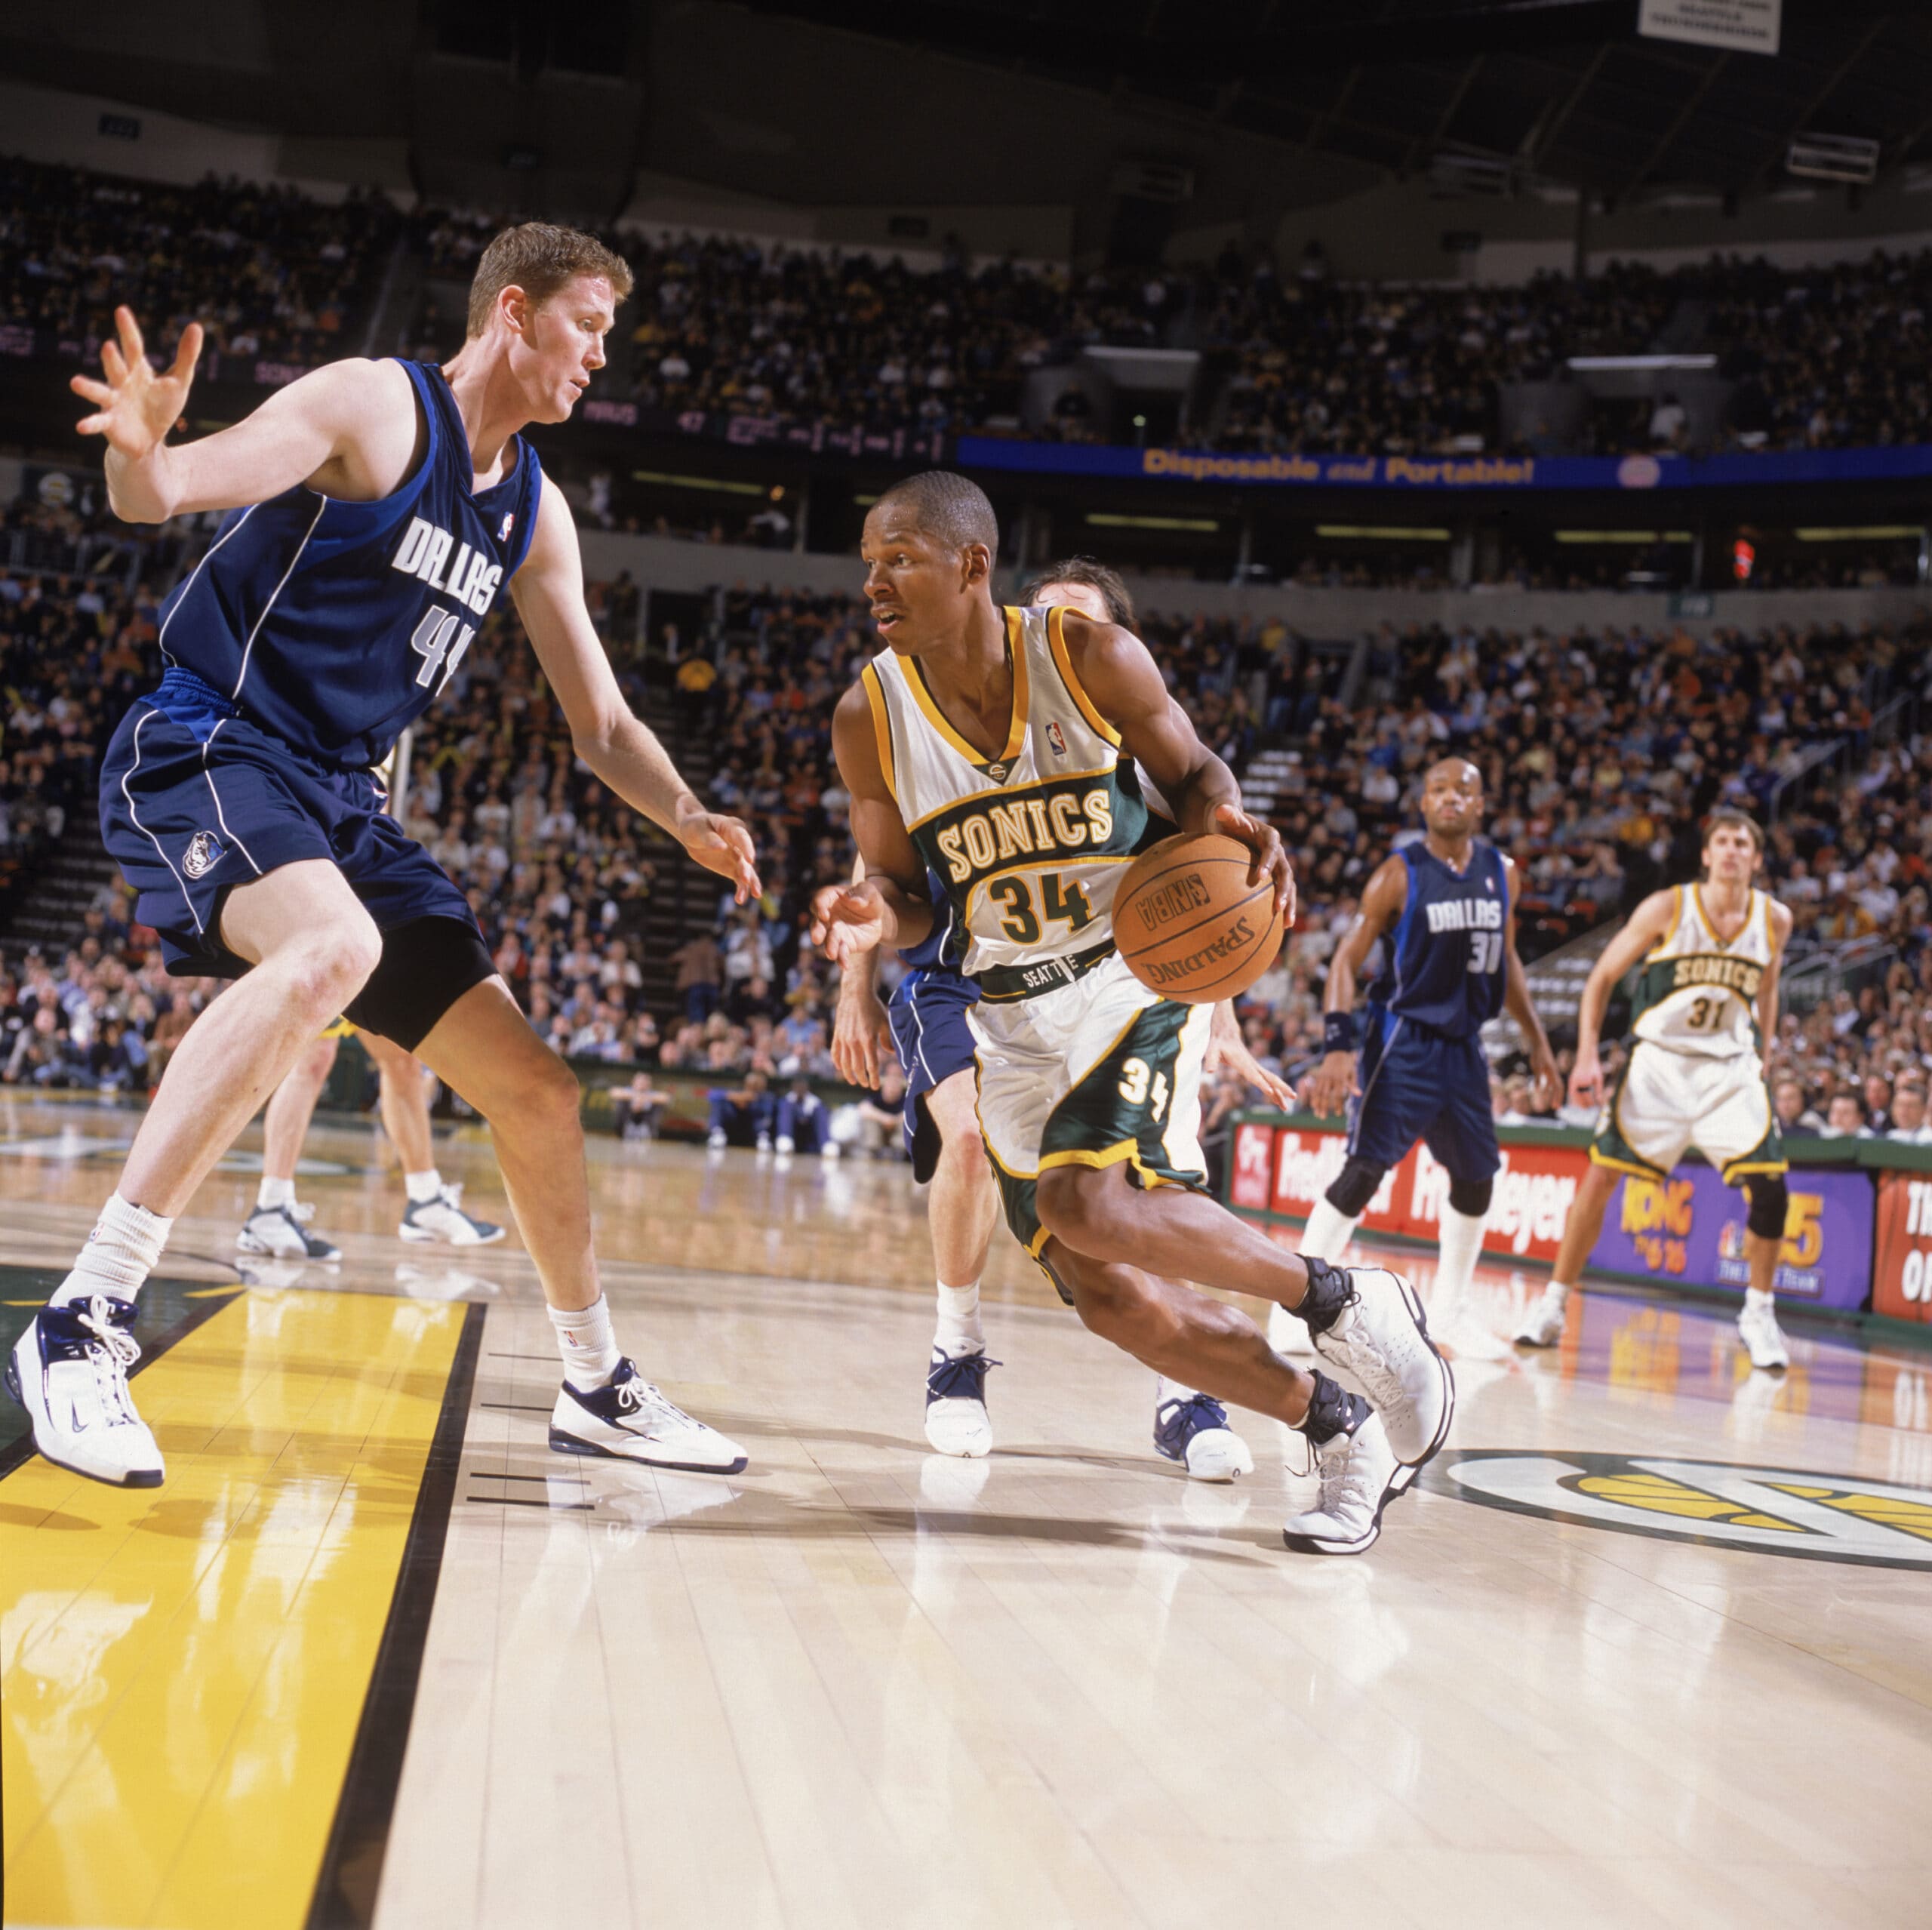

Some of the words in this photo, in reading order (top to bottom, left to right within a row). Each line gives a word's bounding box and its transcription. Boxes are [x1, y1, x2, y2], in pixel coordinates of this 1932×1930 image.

[1143, 448, 1319, 482] Disposable
[1327, 457, 1376, 481] and
[1386, 456, 1534, 484] Portable!
[392, 516, 503, 616] DALLAS
[937, 789, 1113, 884] SONICS
[986, 872, 1094, 946] 34
[1135, 879, 1193, 932] NBA
[1426, 897, 1502, 934] DALLAS
[1023, 955, 1078, 988] SEATTE
[1145, 916, 1255, 984] SPALDING
[1466, 931, 1503, 974] 31
[1673, 956, 1761, 996] SONICS
[1687, 996, 1726, 1031] 31
